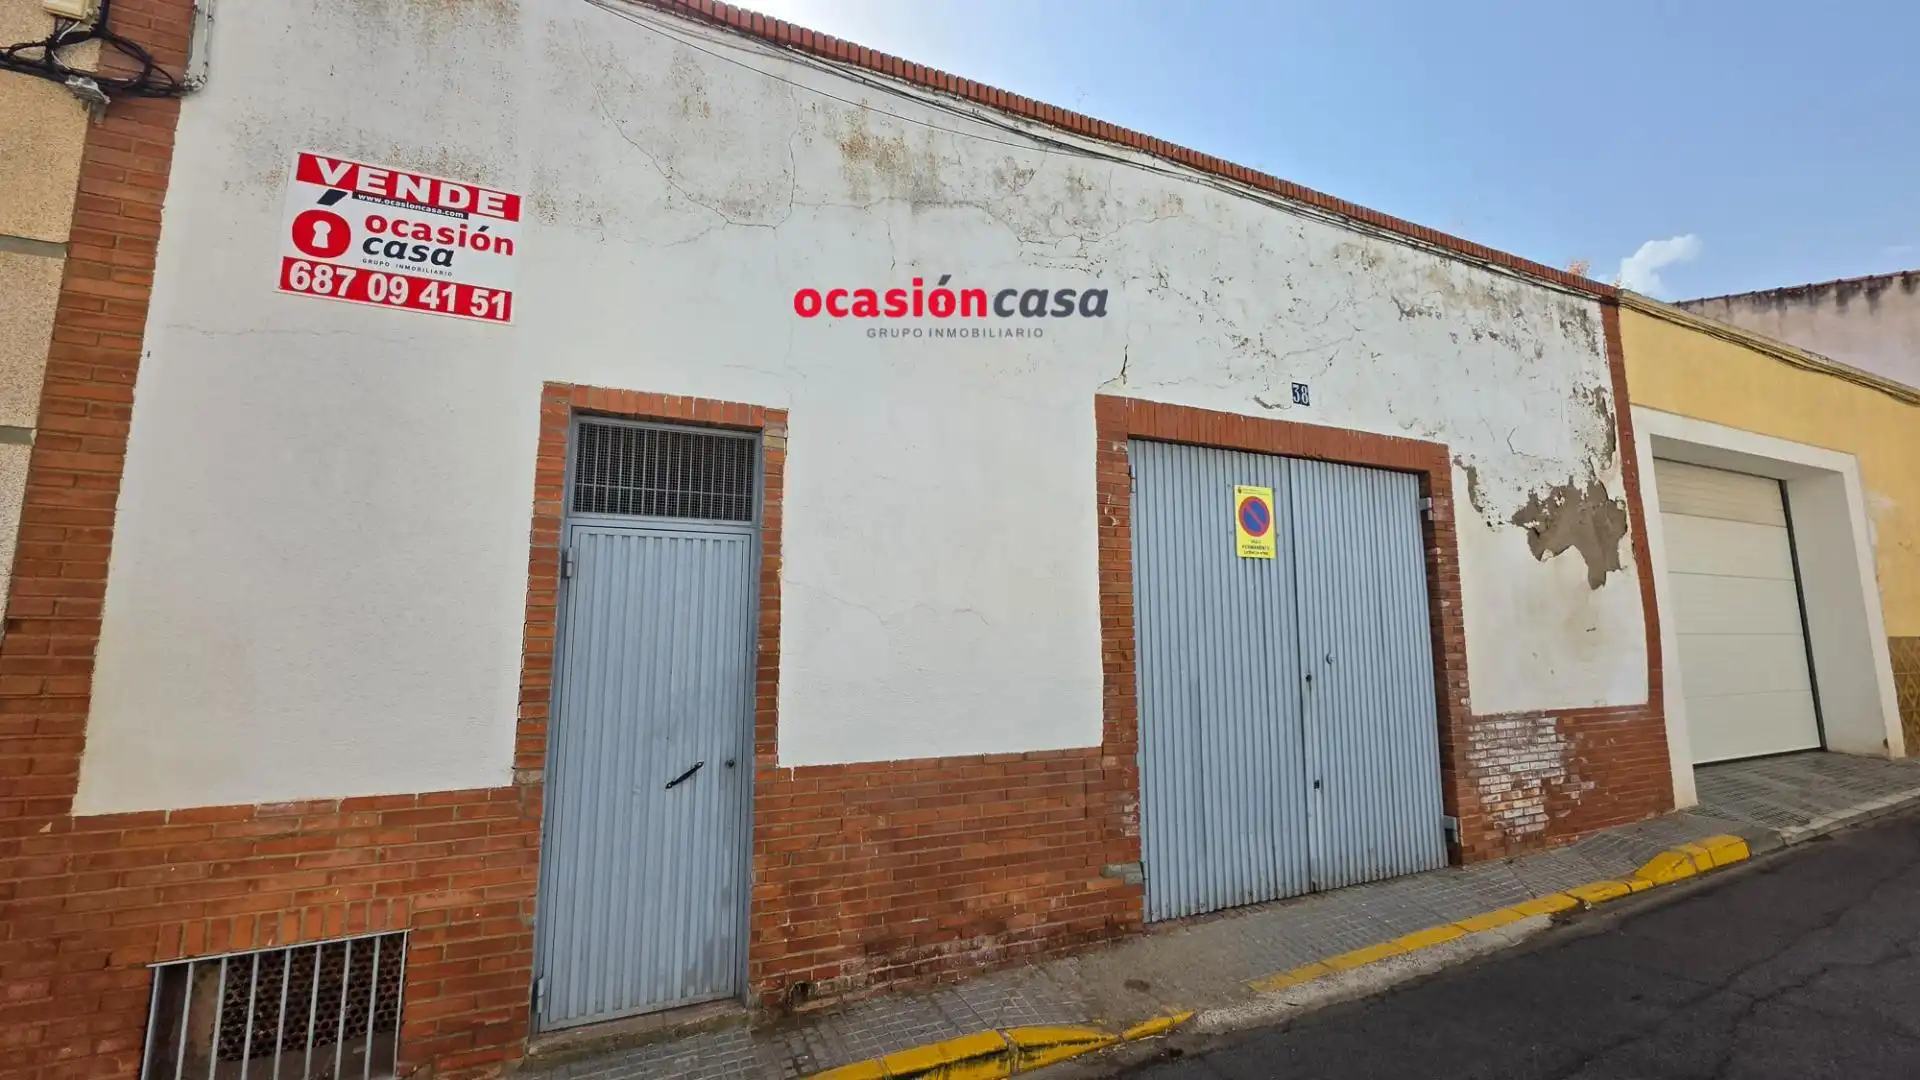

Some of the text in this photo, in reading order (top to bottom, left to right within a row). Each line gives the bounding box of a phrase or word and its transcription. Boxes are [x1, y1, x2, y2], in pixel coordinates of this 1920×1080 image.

[315, 156, 507, 218] VENDE
[358, 193, 464, 219] www.ocasioncasa.com
[364, 214, 514, 256] ocasión
[362, 237, 454, 267] casa
[362, 258, 453, 277] GRUPO INMOBILIARIO
[289, 260, 505, 319] 687 09 41 51
[1292, 383, 1309, 404] 38
